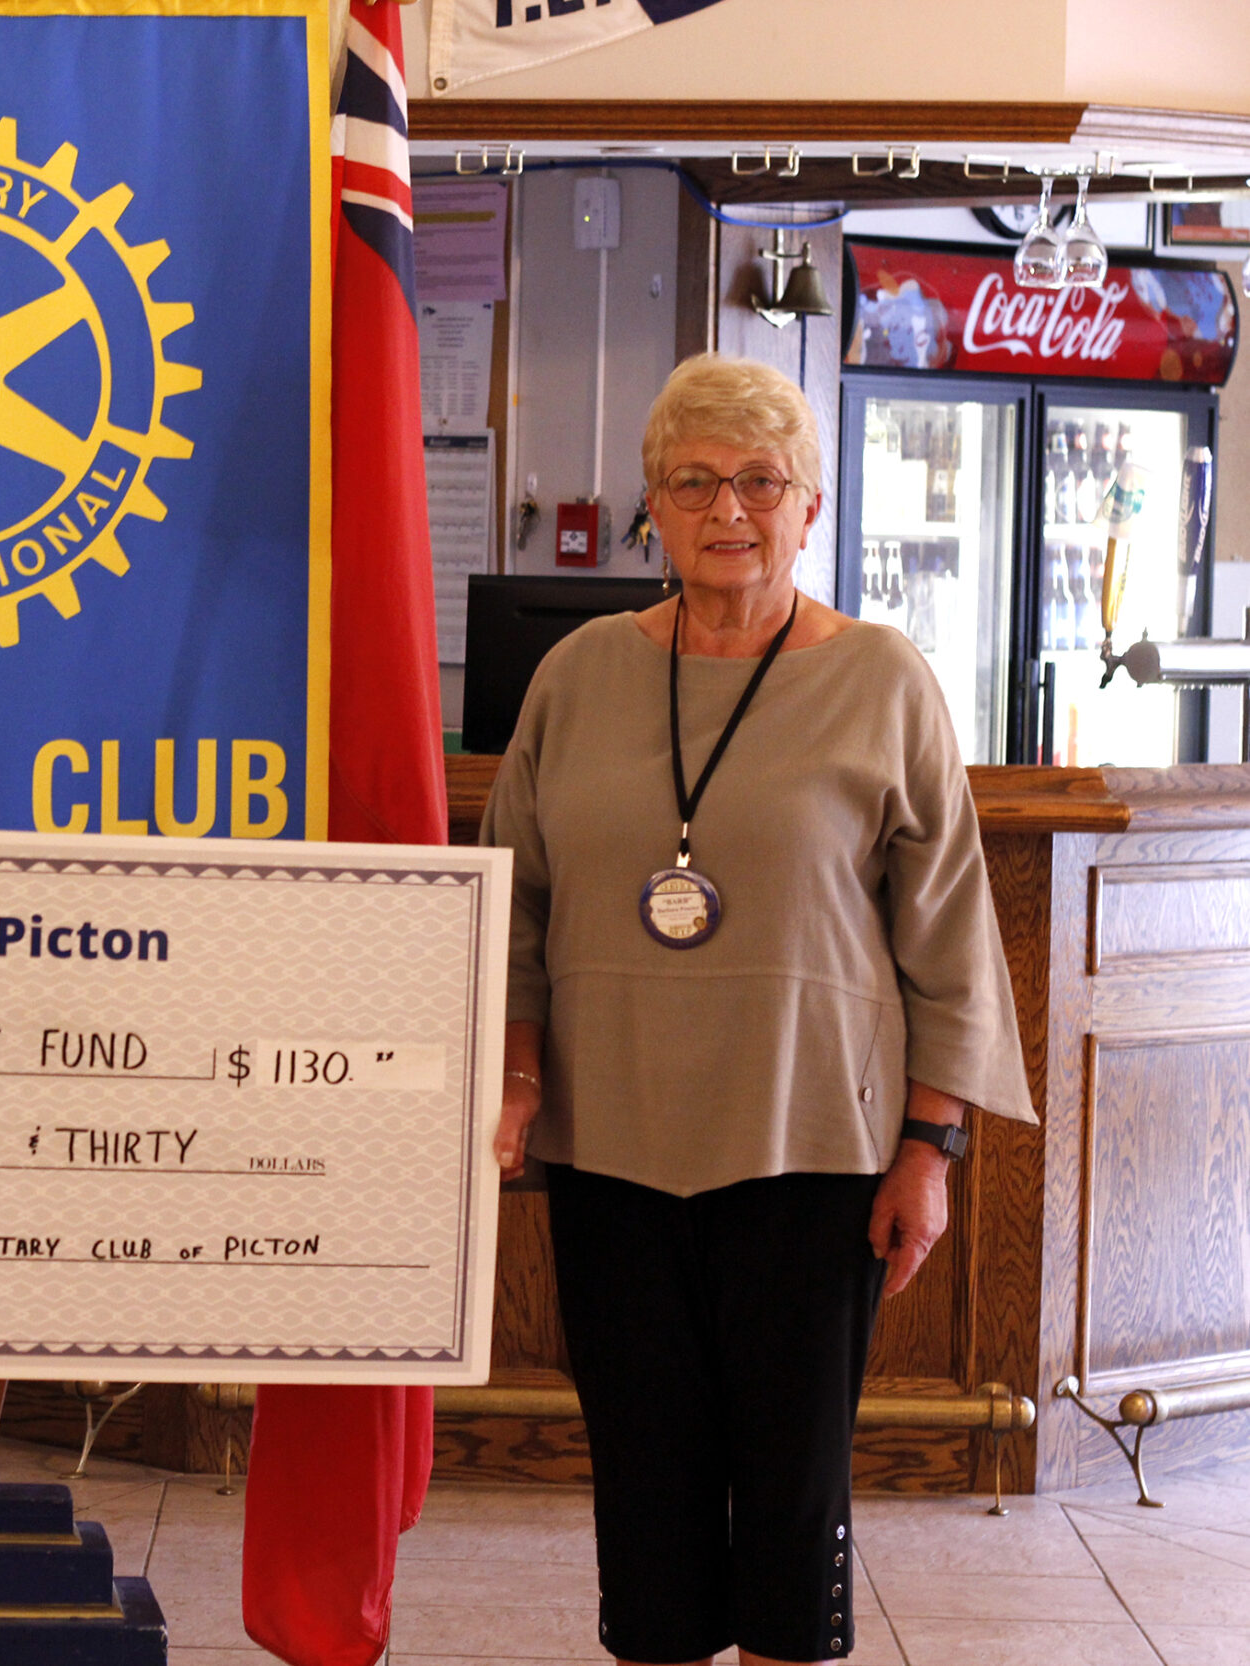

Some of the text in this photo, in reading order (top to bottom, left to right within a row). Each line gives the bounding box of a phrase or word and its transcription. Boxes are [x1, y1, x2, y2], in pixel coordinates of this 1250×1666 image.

[31, 738, 288, 838] CLUB
[40, 1029, 148, 1070] FUND
[228, 1044, 251, 1088] $
[55, 1127, 198, 1165] THIRTY
[249, 1156, 327, 1171] DOLLARS
[91, 1238, 152, 1261] CLUB
[224, 1234, 321, 1261] PICTON
